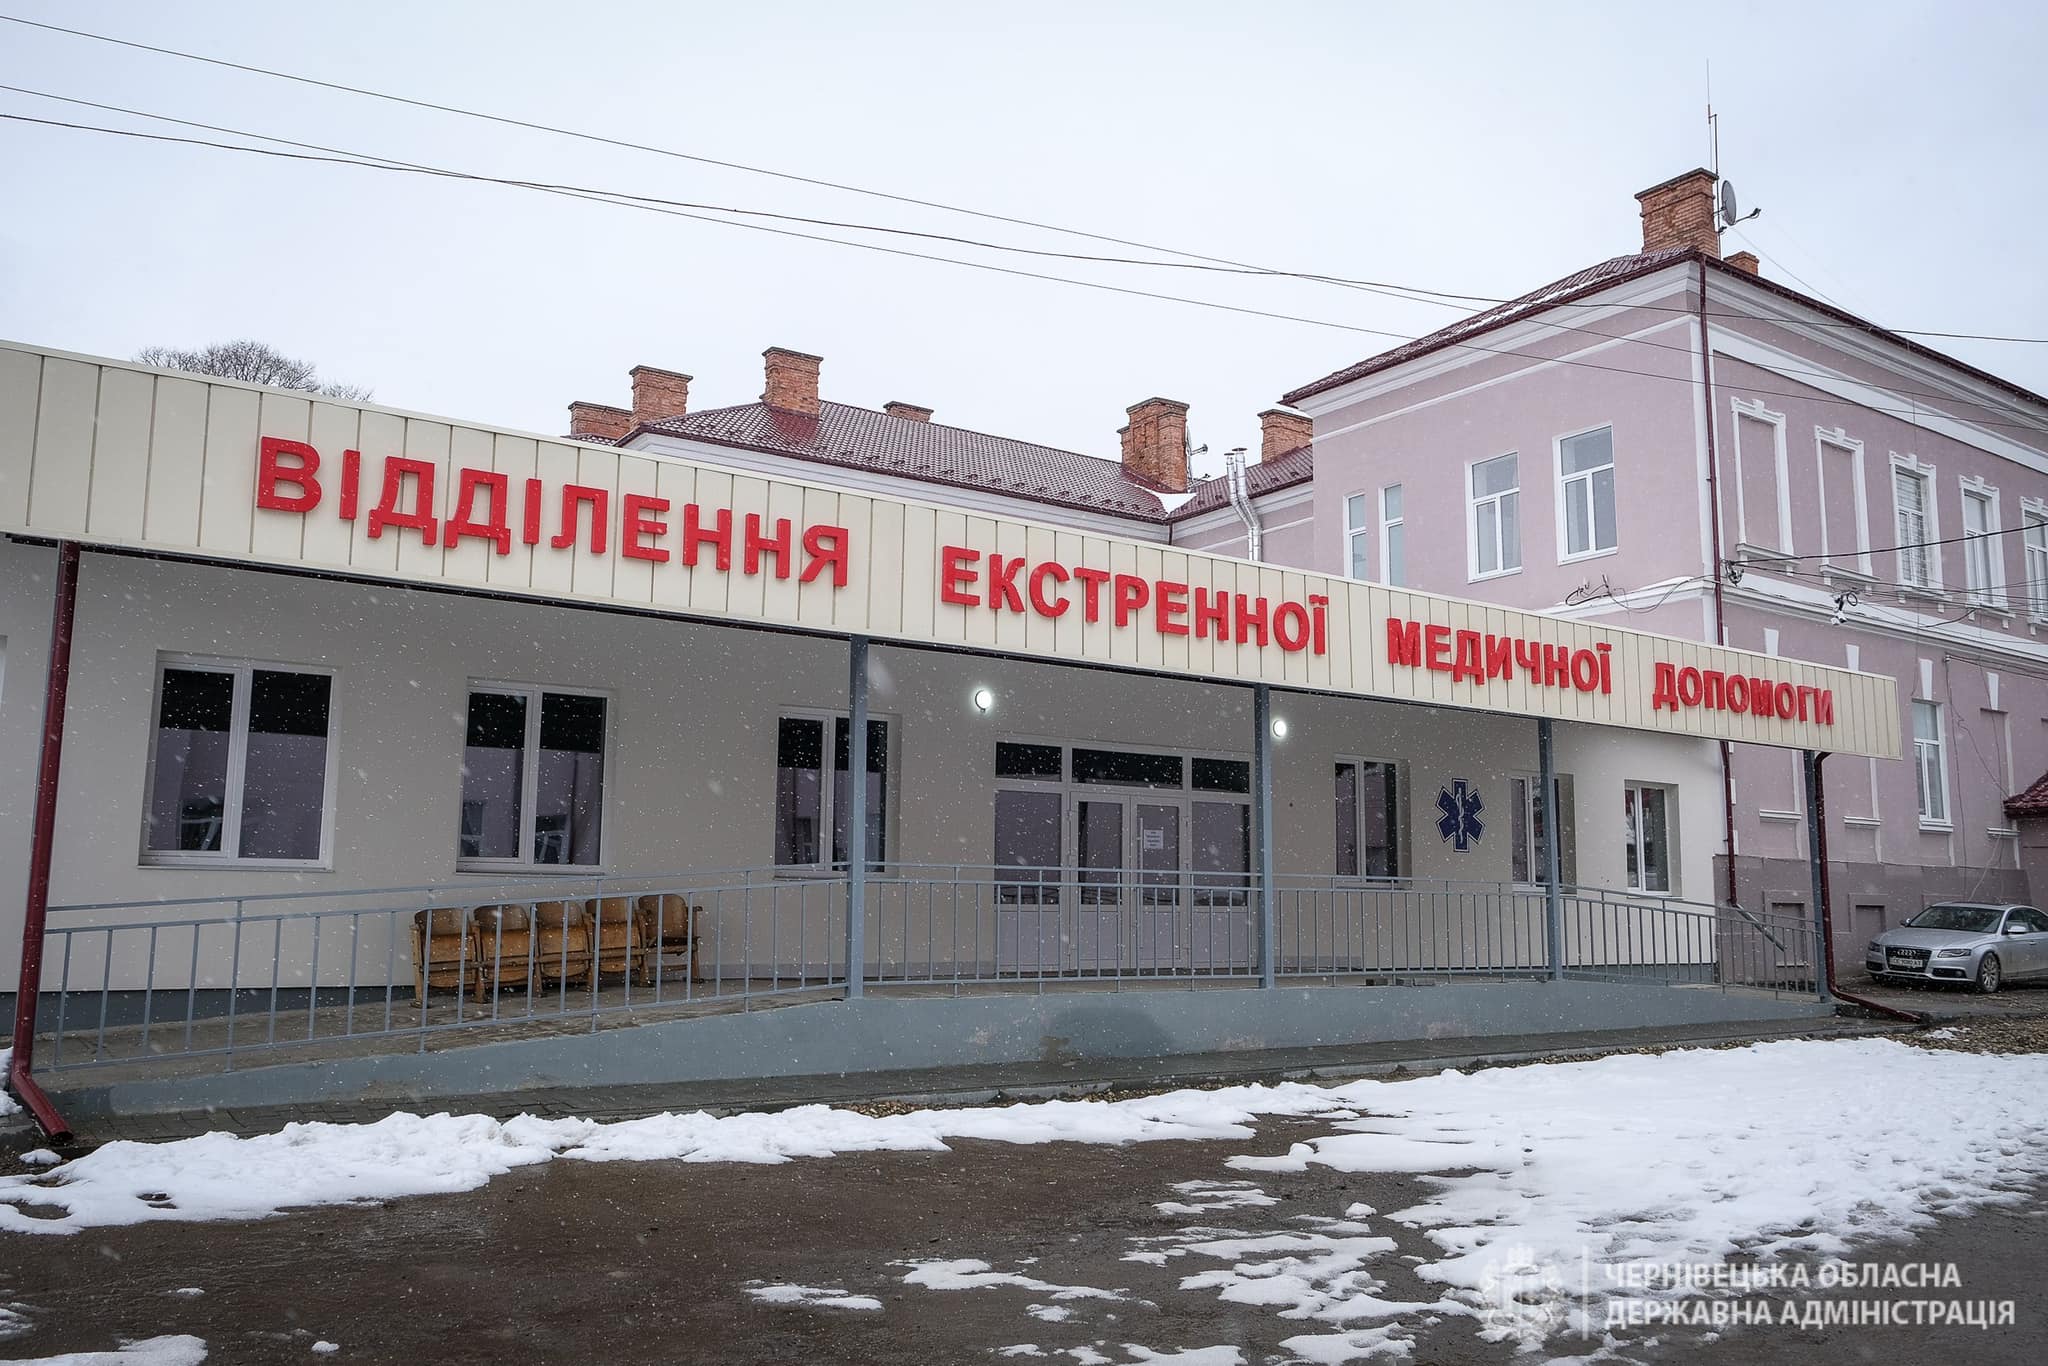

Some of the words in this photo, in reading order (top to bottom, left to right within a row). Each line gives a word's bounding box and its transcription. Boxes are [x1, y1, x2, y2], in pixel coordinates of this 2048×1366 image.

[258, 437, 850, 589] ВІДДІЛЕННЯ
[942, 546, 1329, 656] ЕКСТРЕННОЇ
[1388, 618, 1612, 695] МЕДИЧНОЇ
[1653, 663, 1834, 726] ДОПОМОГИ
